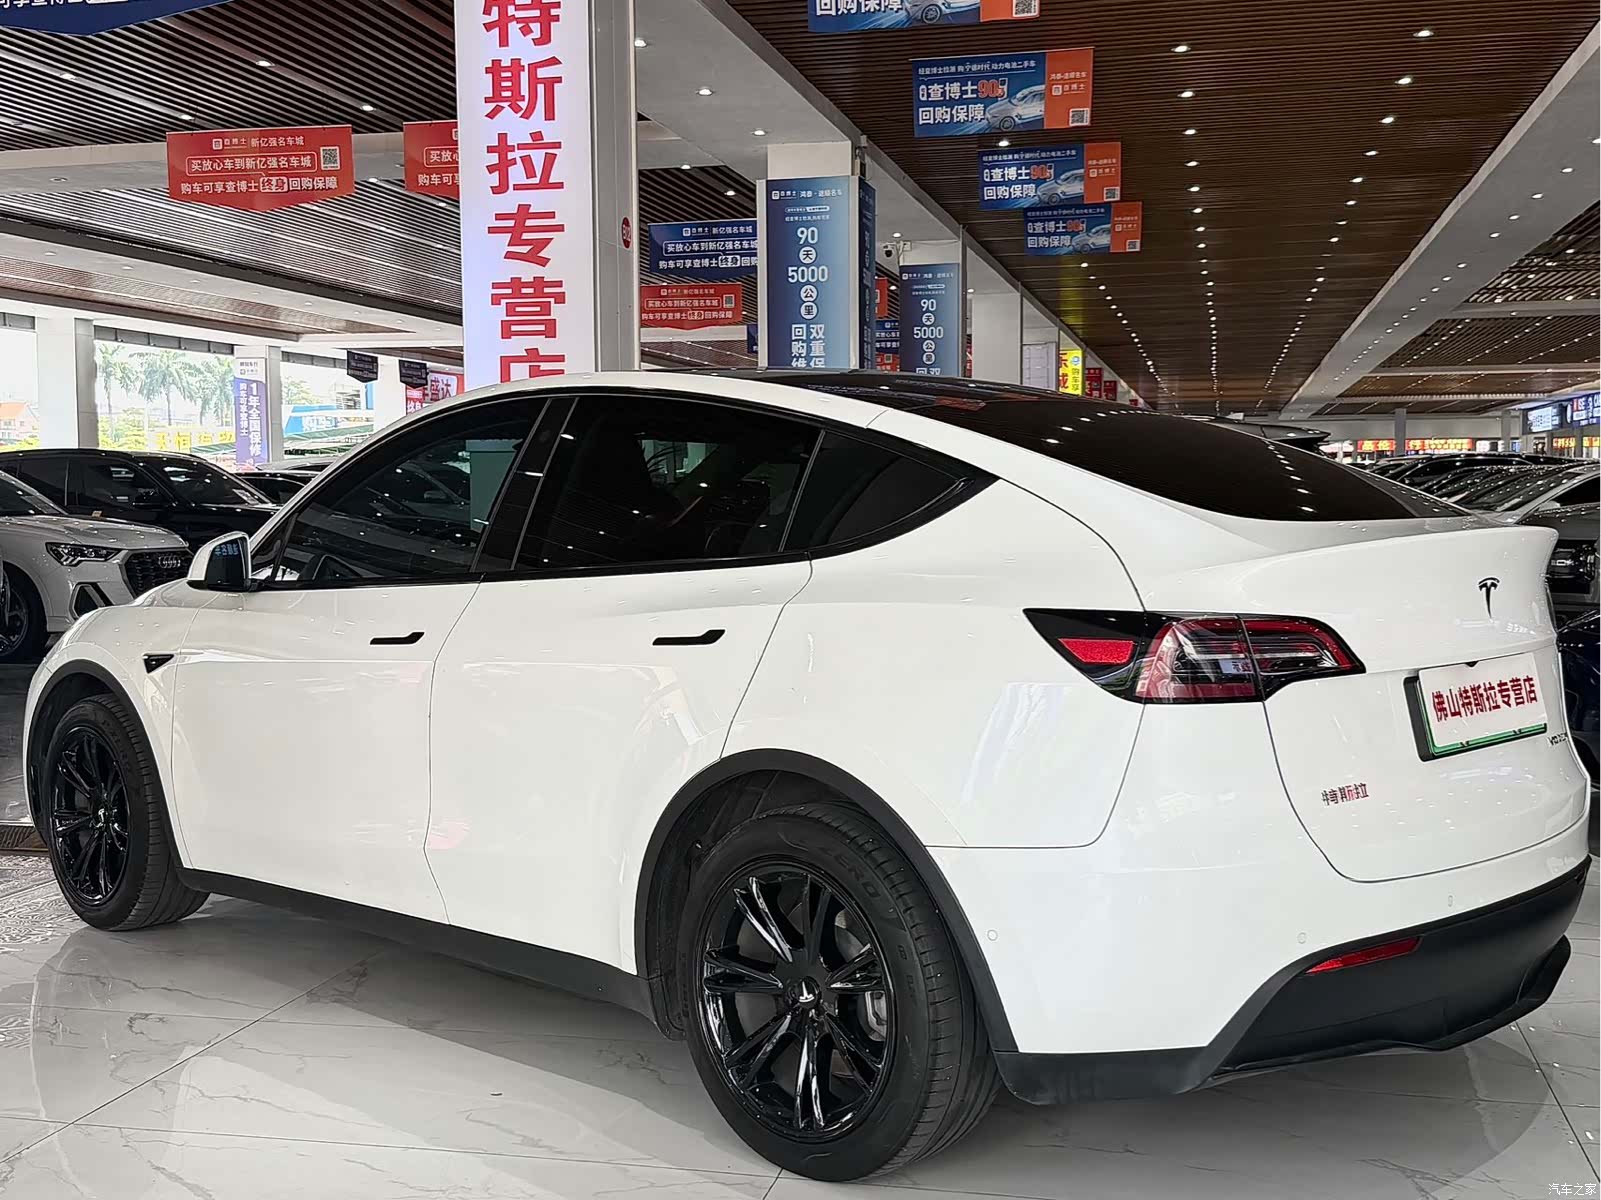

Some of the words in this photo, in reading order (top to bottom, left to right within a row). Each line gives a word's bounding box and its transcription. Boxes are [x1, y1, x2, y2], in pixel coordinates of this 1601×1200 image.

[918, 104, 985, 124] 回购保障
[251, 136, 304, 147] 新亿强名车城
[191, 155, 312, 171] 买放心车到新亿强名车城
[984, 184, 1036, 200] 回购保障
[797, 227, 818, 244] 90
[802, 249, 813, 261] 天
[788, 266, 828, 282] 5000
[921, 299, 936, 311] 90
[913, 327, 944, 339] 5000
[1431, 675, 1538, 722] 佛山特斯拉专营店
[1321, 783, 1369, 806] 特斯拉
